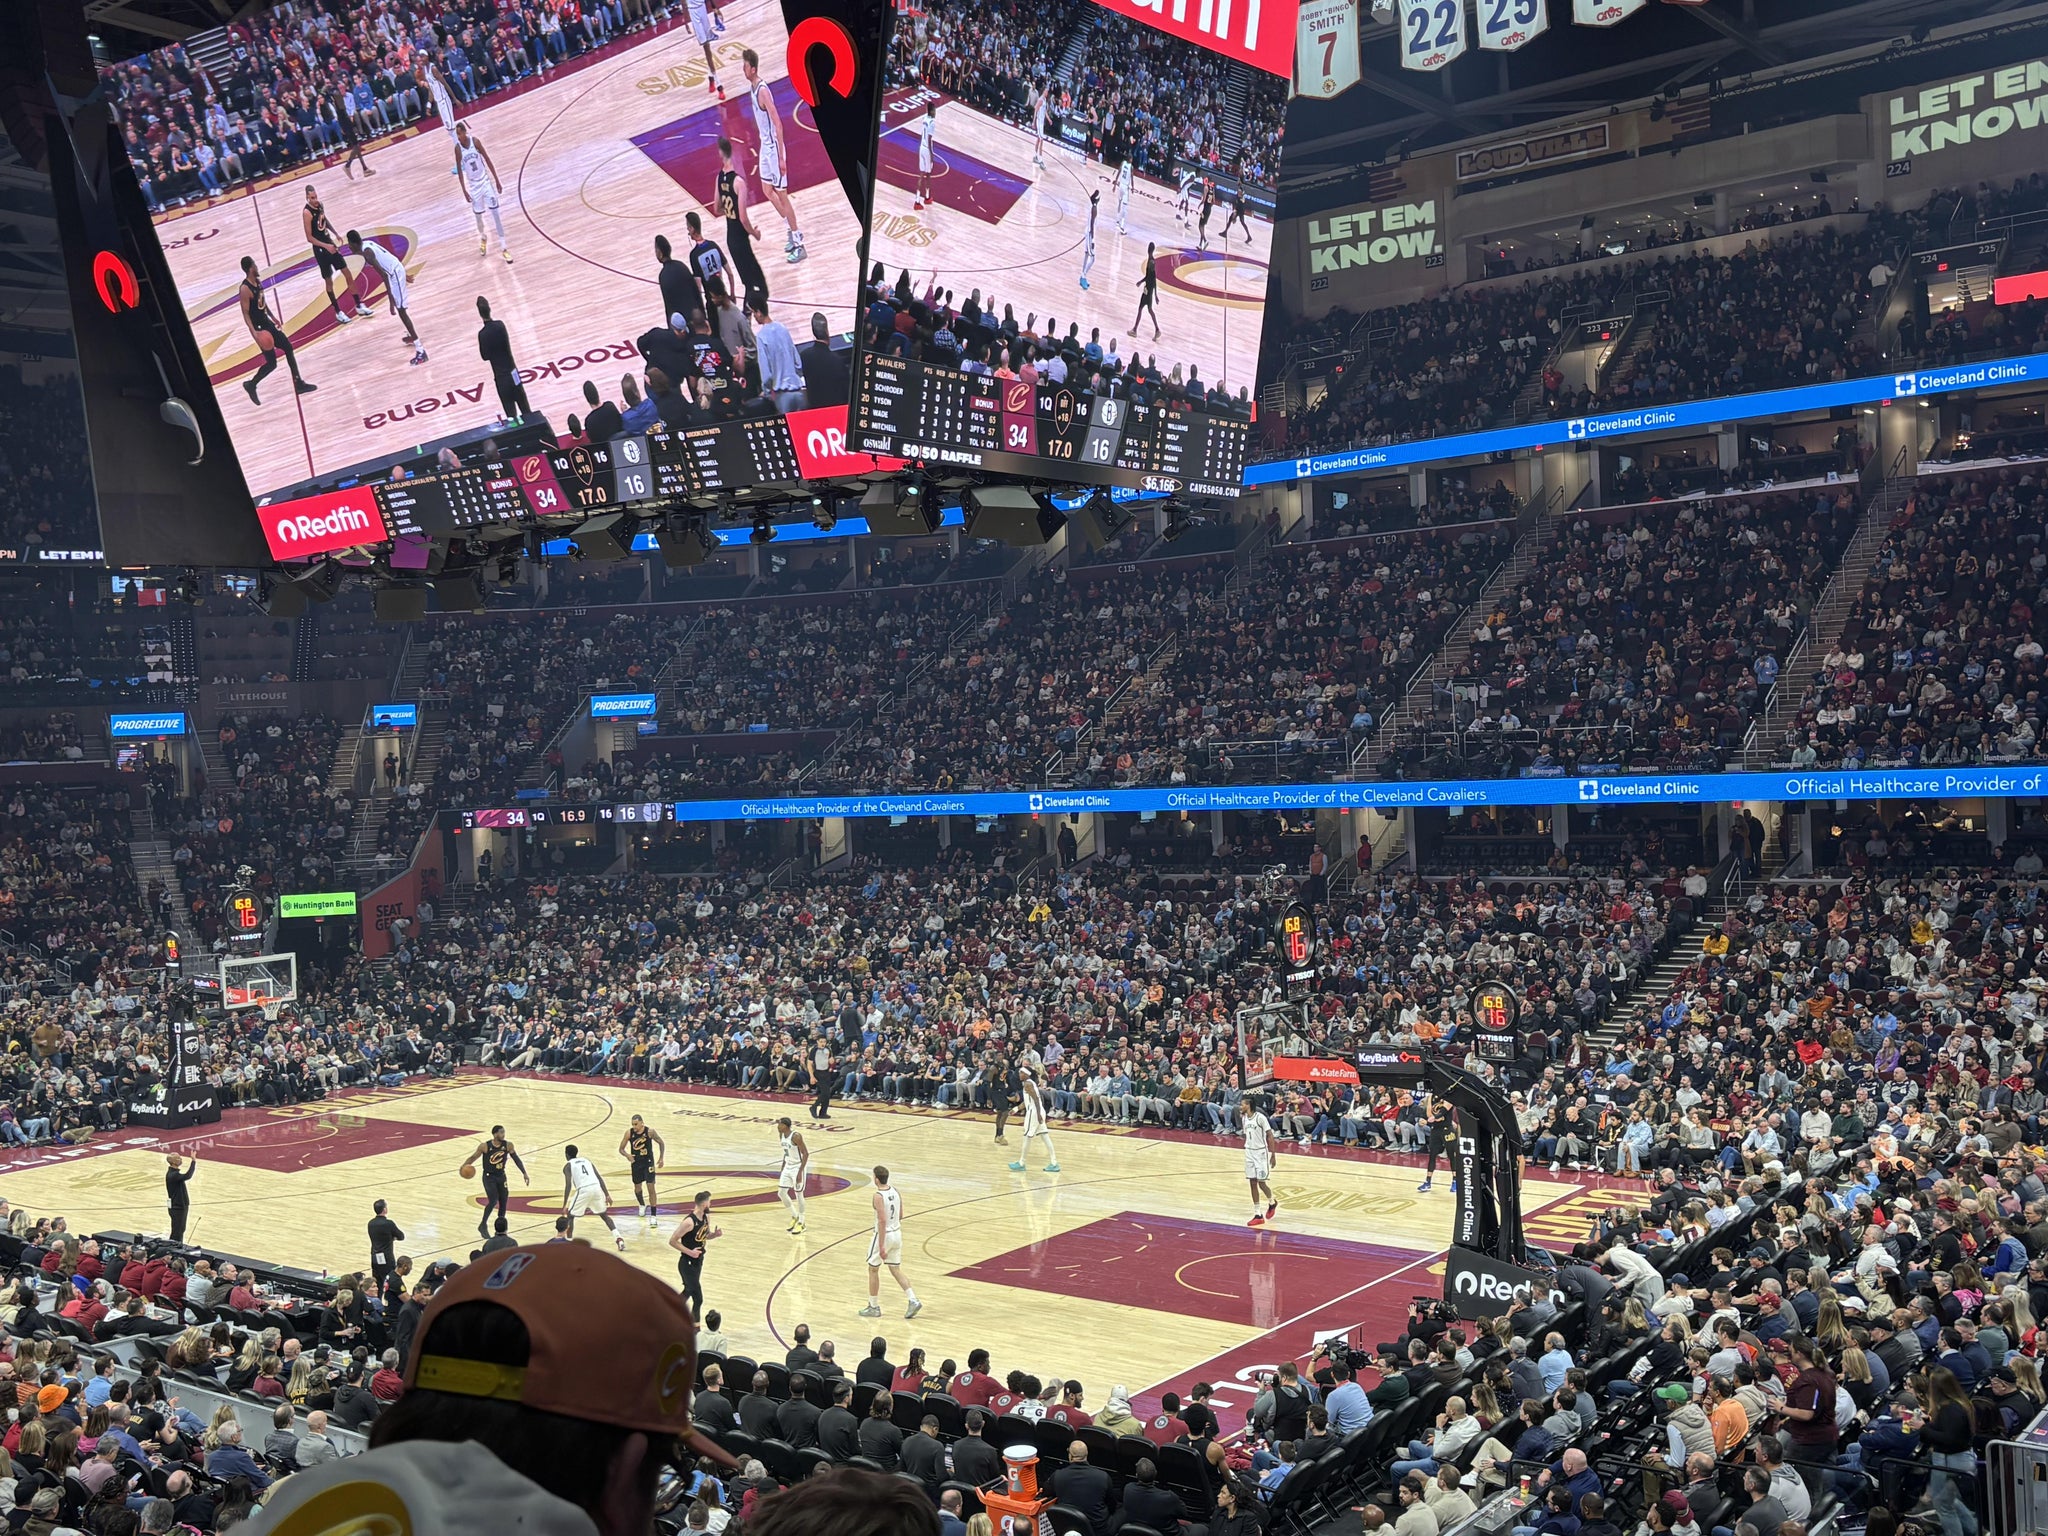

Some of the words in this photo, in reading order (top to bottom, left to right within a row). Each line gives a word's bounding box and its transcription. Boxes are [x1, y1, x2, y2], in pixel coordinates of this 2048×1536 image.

[1301, 11, 1323, 22] BOBBY
[1309, 14, 1345, 32] SMITH
[1486, 0, 1538, 34] 25
[1407, 3, 1458, 55] 22
[1317, 31, 1338, 77] 7
[888, 87, 941, 115] CLIFFS
[1890, 75, 1985, 126] LET
[1887, 161, 1911, 177] 224
[1308, 210, 1377, 244] LET
[1382, 199, 1436, 231] EM
[1310, 229, 1443, 274] KNOW.
[1978, 243, 1997, 255] 225
[706, 255, 718, 271] 24
[1425, 254, 1444, 268] 223
[1920, 253, 1938, 264] 224
[1310, 277, 1329, 291] 222
[876, 357, 907, 371] CAVALIERS
[923, 366, 933, 375] PTS
[948, 371, 957, 379] AST
[876, 370, 898, 382] MERRILL
[978, 375, 994, 386] FOULS
[1918, 368, 1985, 390] Cleveland
[1988, 363, 2028, 380] Clinic
[982, 385, 988, 395] 3
[363, 381, 485, 431] Arena
[861, 393, 870, 402] 20
[873, 396, 892, 406] TYSON
[975, 399, 994, 410] BONUS
[1039, 396, 1052, 411] 1Q
[860, 406, 869, 416] 32
[872, 409, 889, 418] WADE
[1076, 402, 1087, 416] 16
[1134, 404, 1149, 415] FOULS
[1168, 411, 1181, 421] NETS
[1138, 413, 1144, 422] 5
[1588, 415, 1643, 434] Cleveland
[1644, 411, 1676, 427] Clinic
[859, 419, 868, 429] 45
[871, 421, 897, 433] MITCHELL
[988, 427, 996, 437] 57
[654, 433, 670, 442] FOULS
[863, 436, 892, 451] oswald
[1008, 424, 1028, 448] 34
[661, 442, 667, 451] 5
[1048, 437, 1073, 460] 17.0
[1092, 438, 1110, 461] 16
[554, 456, 569, 471] 1Q
[594, 450, 608, 464] 16
[940, 449, 982, 466] RAFFLE
[1312, 455, 1358, 472] Cleveland
[1359, 451, 1387, 466] Clinic
[487, 462, 503, 471] FOULS
[490, 479, 513, 490] BONUS
[624, 473, 646, 496] 16
[1145, 477, 1176, 493] $6,166
[1189, 482, 1241, 498] CAVS5050.COM
[536, 487, 558, 509] 34
[577, 486, 608, 507] 17.0
[295, 505, 370, 541] Redfin
[0, 549, 17, 560] PM
[39, 550, 70, 560] LET
[70, 550, 94, 560] EM
[229, 691, 288, 701] LITEHOUSE
[593, 699, 651, 710] PROGRESSIVE
[113, 718, 181, 730] PROGRESSIVE
[1628, 764, 1659, 774] Huntington
[1666, 764, 1683, 772] CLUB
[1601, 784, 1661, 797] Cleveland
[1664, 782, 1699, 795] Clinic
[1786, 779, 1845, 795] Official
[1850, 777, 1940, 793] Healthcare
[1945, 775, 2017, 791] Provider
[2023, 774, 2042, 790] of
[1044, 796, 1085, 808] Cleveland
[1087, 795, 1111, 807] Clinic
[1167, 793, 1207, 806] Official
[1210, 792, 1270, 805] Healthcare
[1273, 791, 1321, 804] Provider
[1324, 790, 1337, 803] of
[1340, 790, 1359, 802] the
[1363, 789, 1424, 802] Cleveland
[1427, 787, 1487, 801] Cavaliers
[667, 809, 674, 821] 5
[741, 803, 771, 816] Official
[772, 802, 815, 815] Healthcare
[817, 802, 850, 813] Provider
[853, 801, 862, 813] of
[864, 801, 878, 812] the
[880, 800, 922, 812] Cleveland
[924, 799, 965, 812] Cavaliers
[465, 818, 472, 828] 3
[507, 811, 525, 825] 34
[532, 812, 545, 822] 1Q
[560, 809, 587, 823] 16.9
[600, 808, 613, 820] 16
[619, 807, 636, 821] 16
[235, 898, 252, 910] 16.8
[293, 901, 334, 911] Huntington
[336, 900, 354, 909] Bank
[376, 902, 403, 917] SEAT
[240, 909, 257, 928] 16
[1284, 916, 1301, 933] 16.8
[239, 933, 262, 942] TISSOT
[1290, 931, 1306, 961] 16
[1294, 969, 1315, 981] TISSOT
[1483, 995, 1503, 1009] 16.8
[1489, 1009, 1506, 1027] 16
[1487, 1034, 1514, 1043] TISSOT
[1358, 1053, 1399, 1064] KeyBank
[131, 1102, 155, 1115] KeyBank
[581, 1164, 589, 1176] 4
[1463, 1156, 1475, 1209] Cleveland
[1462, 1211, 1475, 1242] Clinic
[1480, 1273, 1565, 1304] Redn
[1017, 1406, 1025, 1416] G
[1034, 1407, 1044, 1418] G
[1008, 1467, 1019, 1482] G
